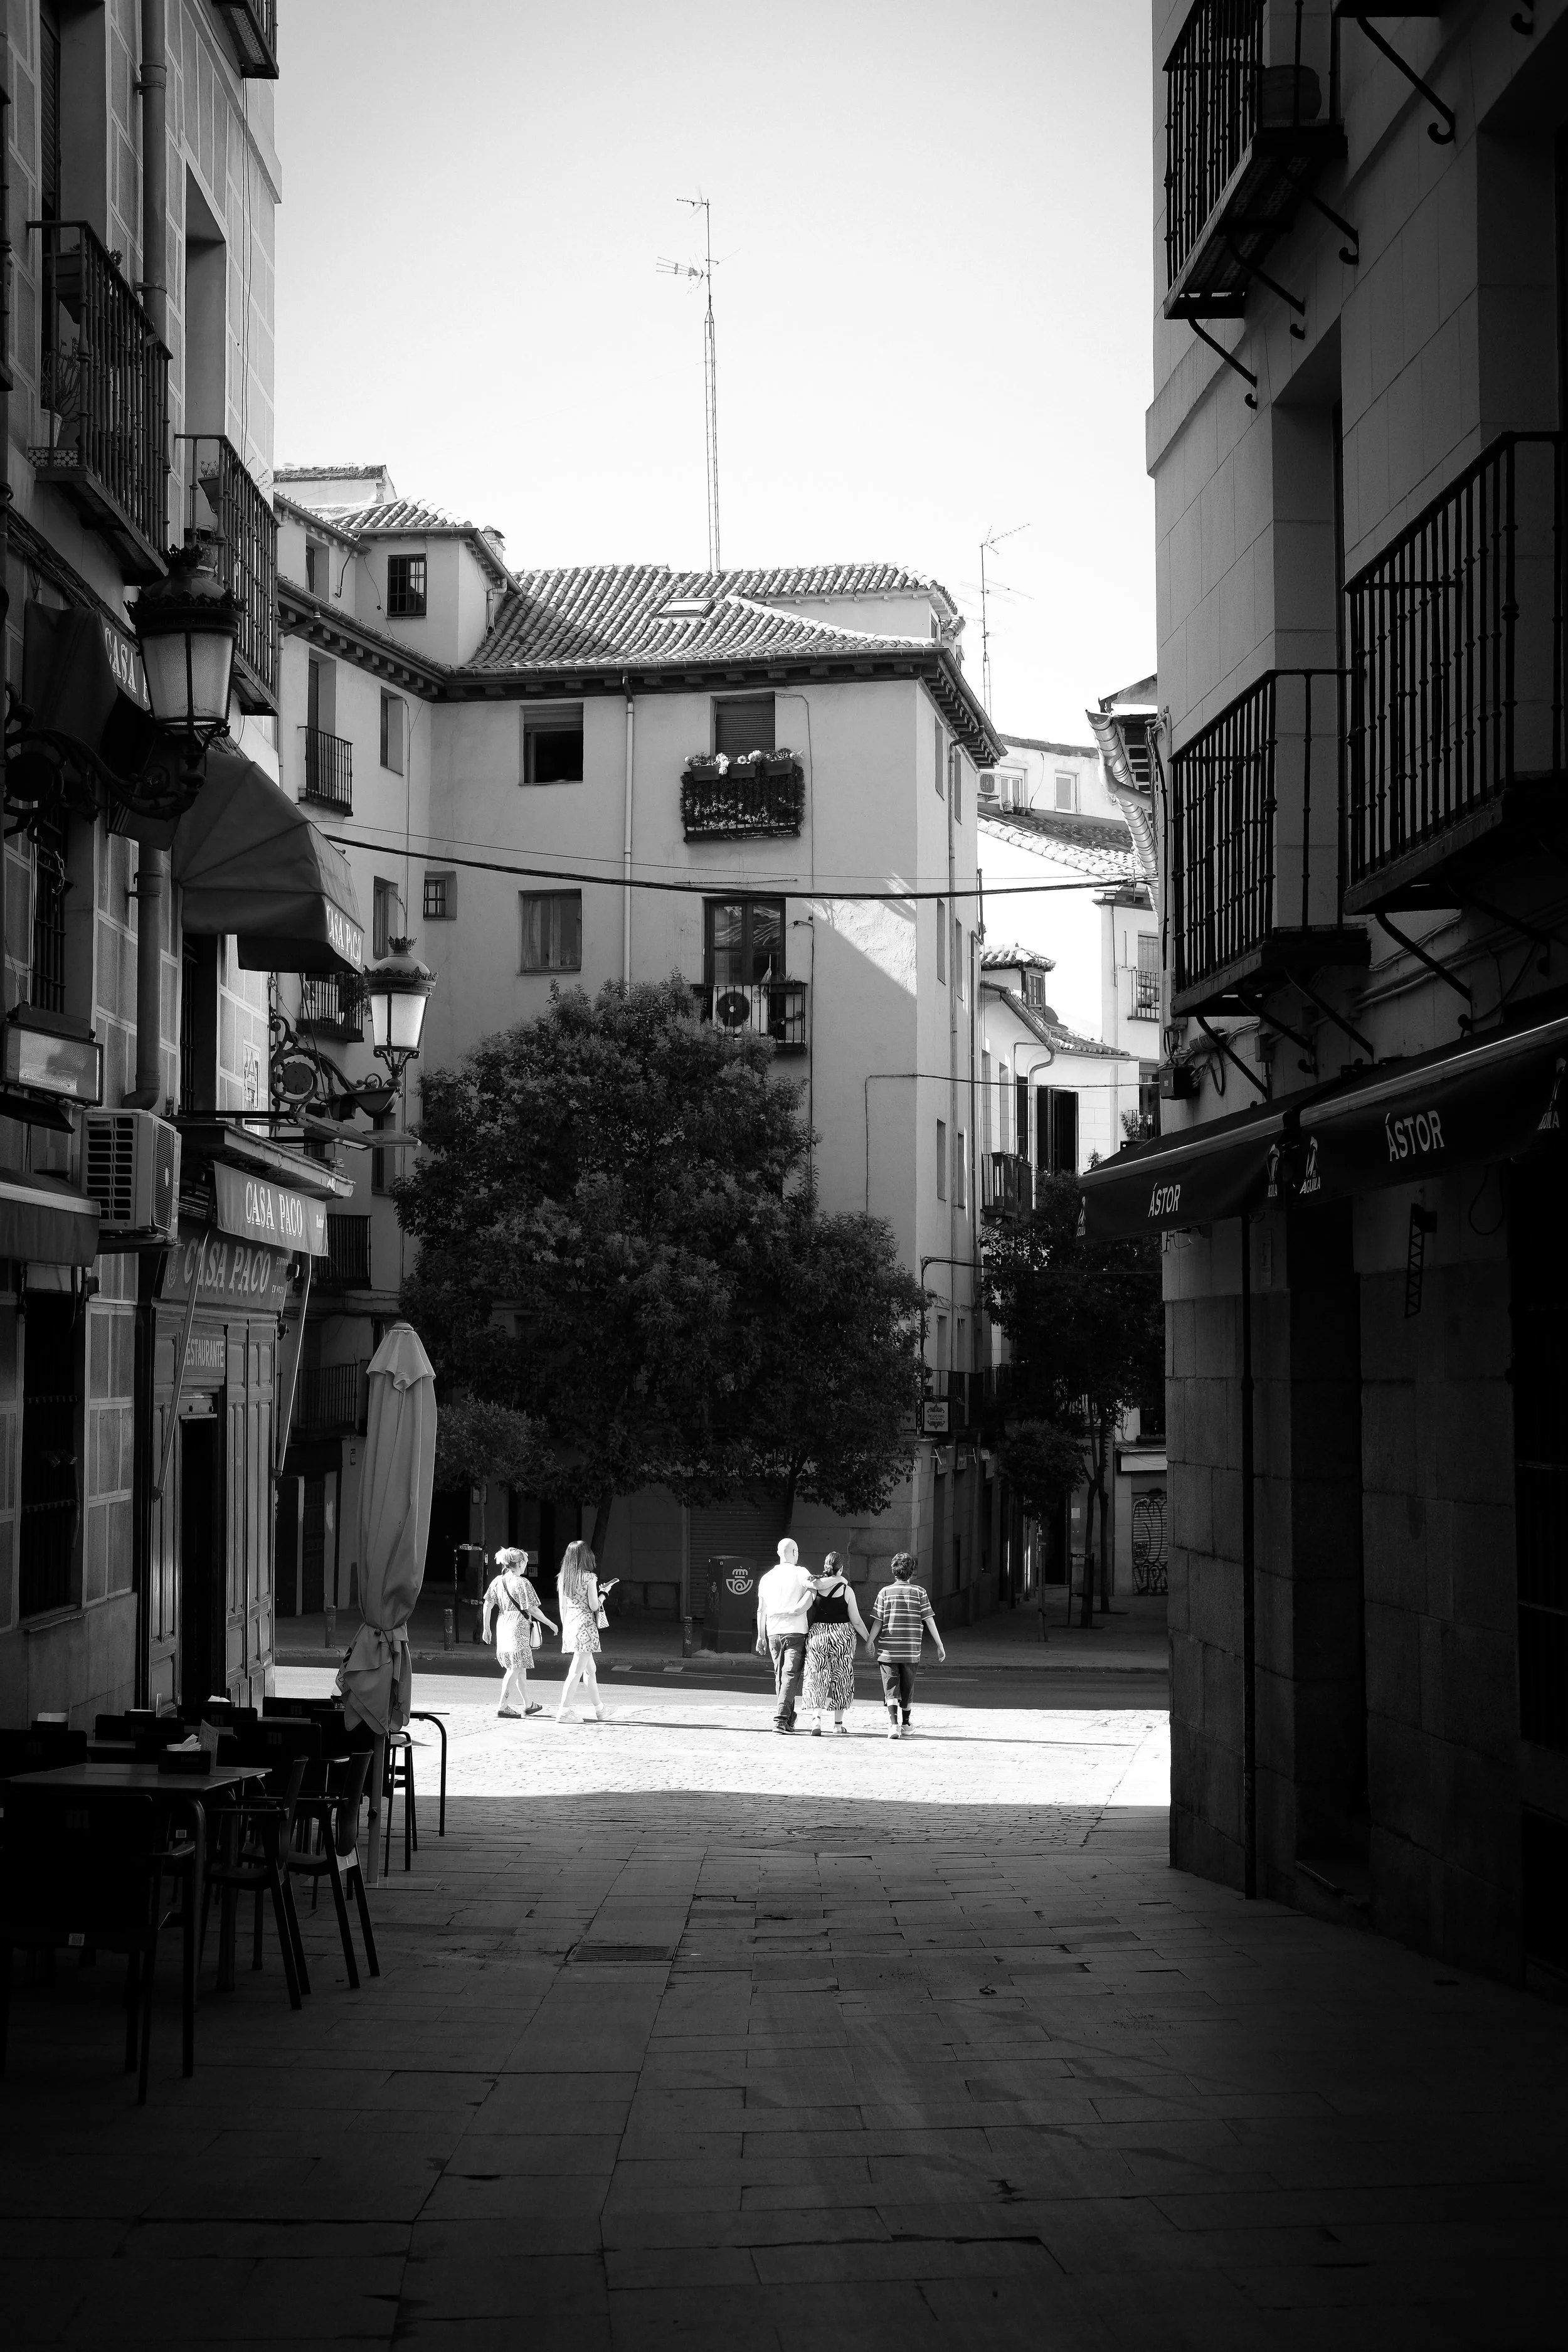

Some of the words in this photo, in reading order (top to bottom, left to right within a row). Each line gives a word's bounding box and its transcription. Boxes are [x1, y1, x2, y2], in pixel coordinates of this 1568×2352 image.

[105, 627, 137, 694] CASA
[1385, 1110, 1445, 1162] ÁSTOR
[245, 1181, 275, 1230] CASA
[278, 1194, 303, 1238] PACO
[1147, 1182, 1181, 1217] ÁSTOR
[228, 1245, 271, 1293] PACO
[184, 1338, 224, 1368] ESTAURANTE
